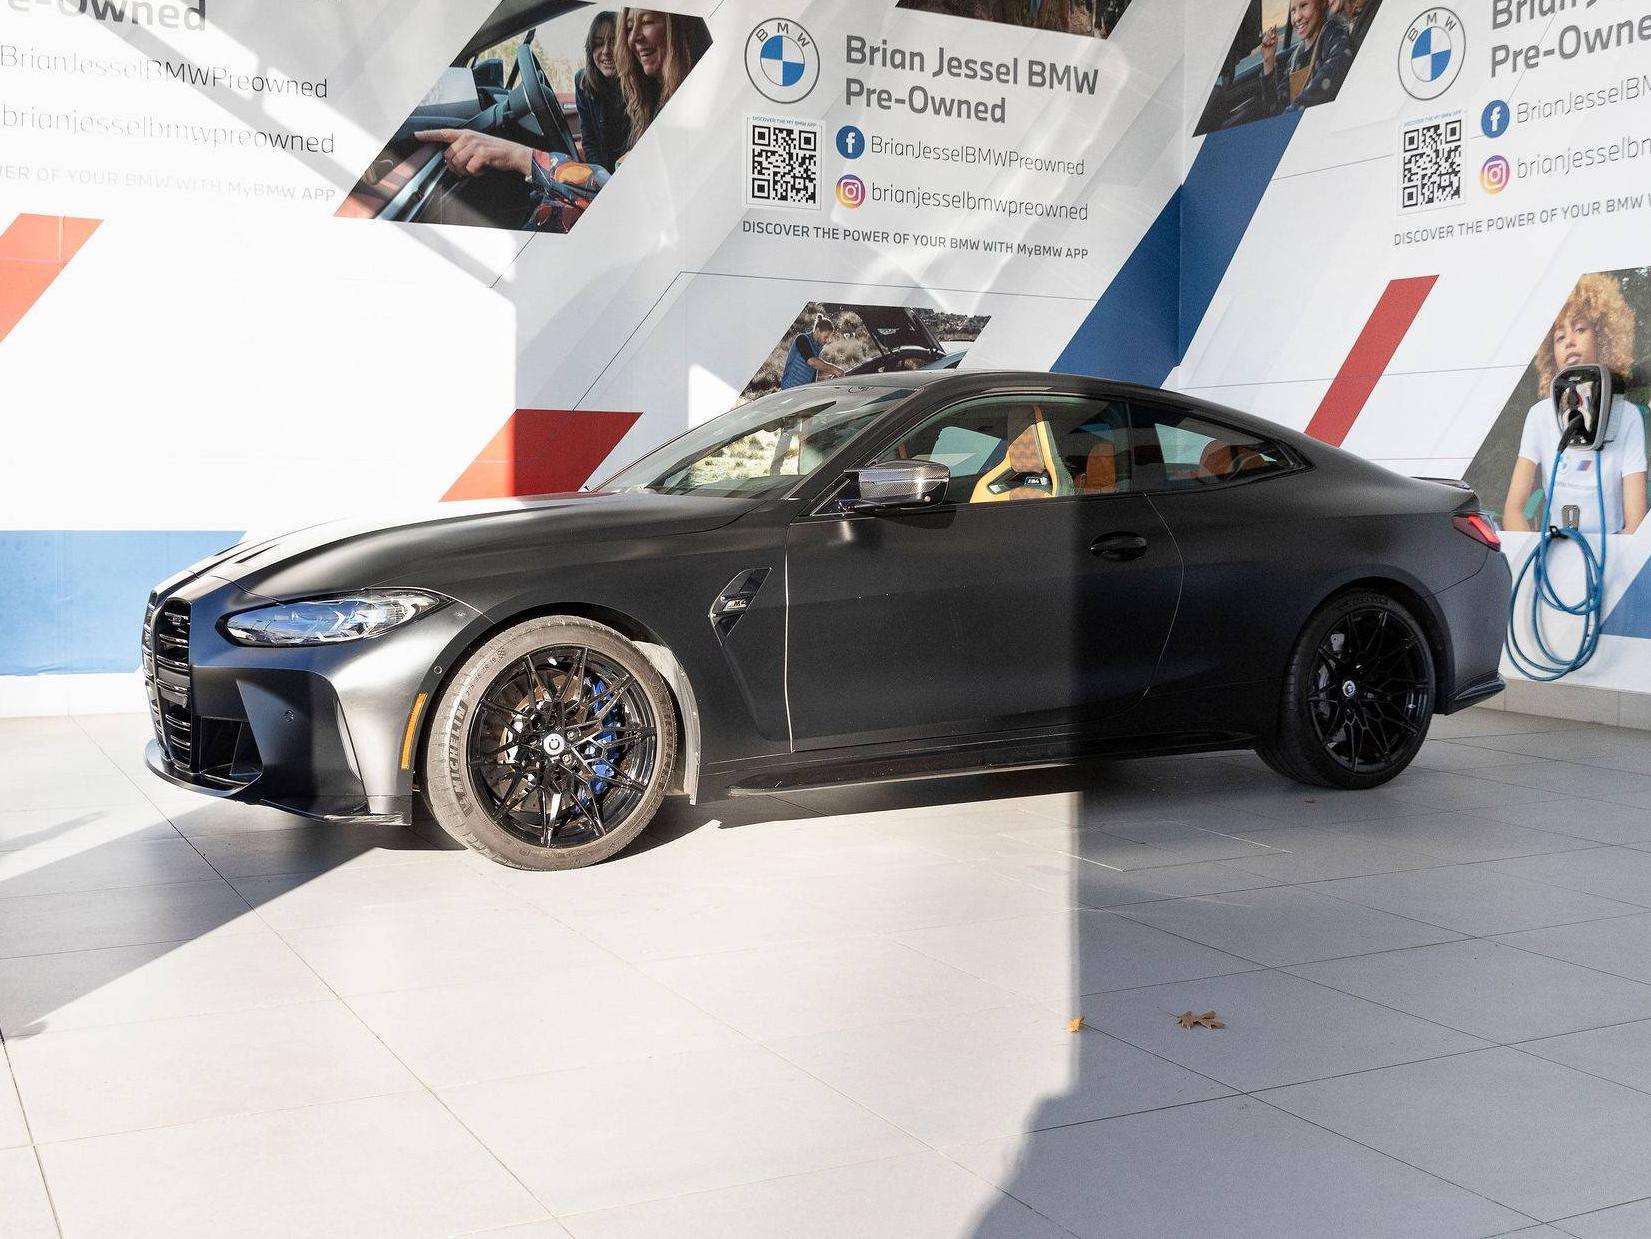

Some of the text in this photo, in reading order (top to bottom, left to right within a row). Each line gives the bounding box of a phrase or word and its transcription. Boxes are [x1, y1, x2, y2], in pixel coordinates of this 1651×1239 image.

[756, 22, 811, 48] BMW
[1408, 12, 1457, 42] BMW
[1490, 14, 1651, 78] Pre-Owne
[0, 45, 328, 98] BrianJesselBMWPreowned
[845, 35, 1099, 95] Brian Jessel BMW
[845, 78, 1006, 123] Pre-Owned
[2, 104, 335, 153] brianjesselbmwpreowned
[871, 135, 1085, 176] BrianJesselBMWPreowned
[302, 187, 335, 200] APP
[871, 182, 1088, 221] brianjesselbmwpreowned
[743, 220, 1088, 259] DISCOVER THE POWER OF YOUR BMW WITH MyBMW APP
[1394, 224, 1455, 246] DISCOVER
[1458, 218, 1483, 236] THE
[1487, 211, 1535, 231] POWER
[1539, 207, 1557, 224] OF
[1562, 201, 1600, 220] YOUR
[1606, 194, 1643, 213] BMW
